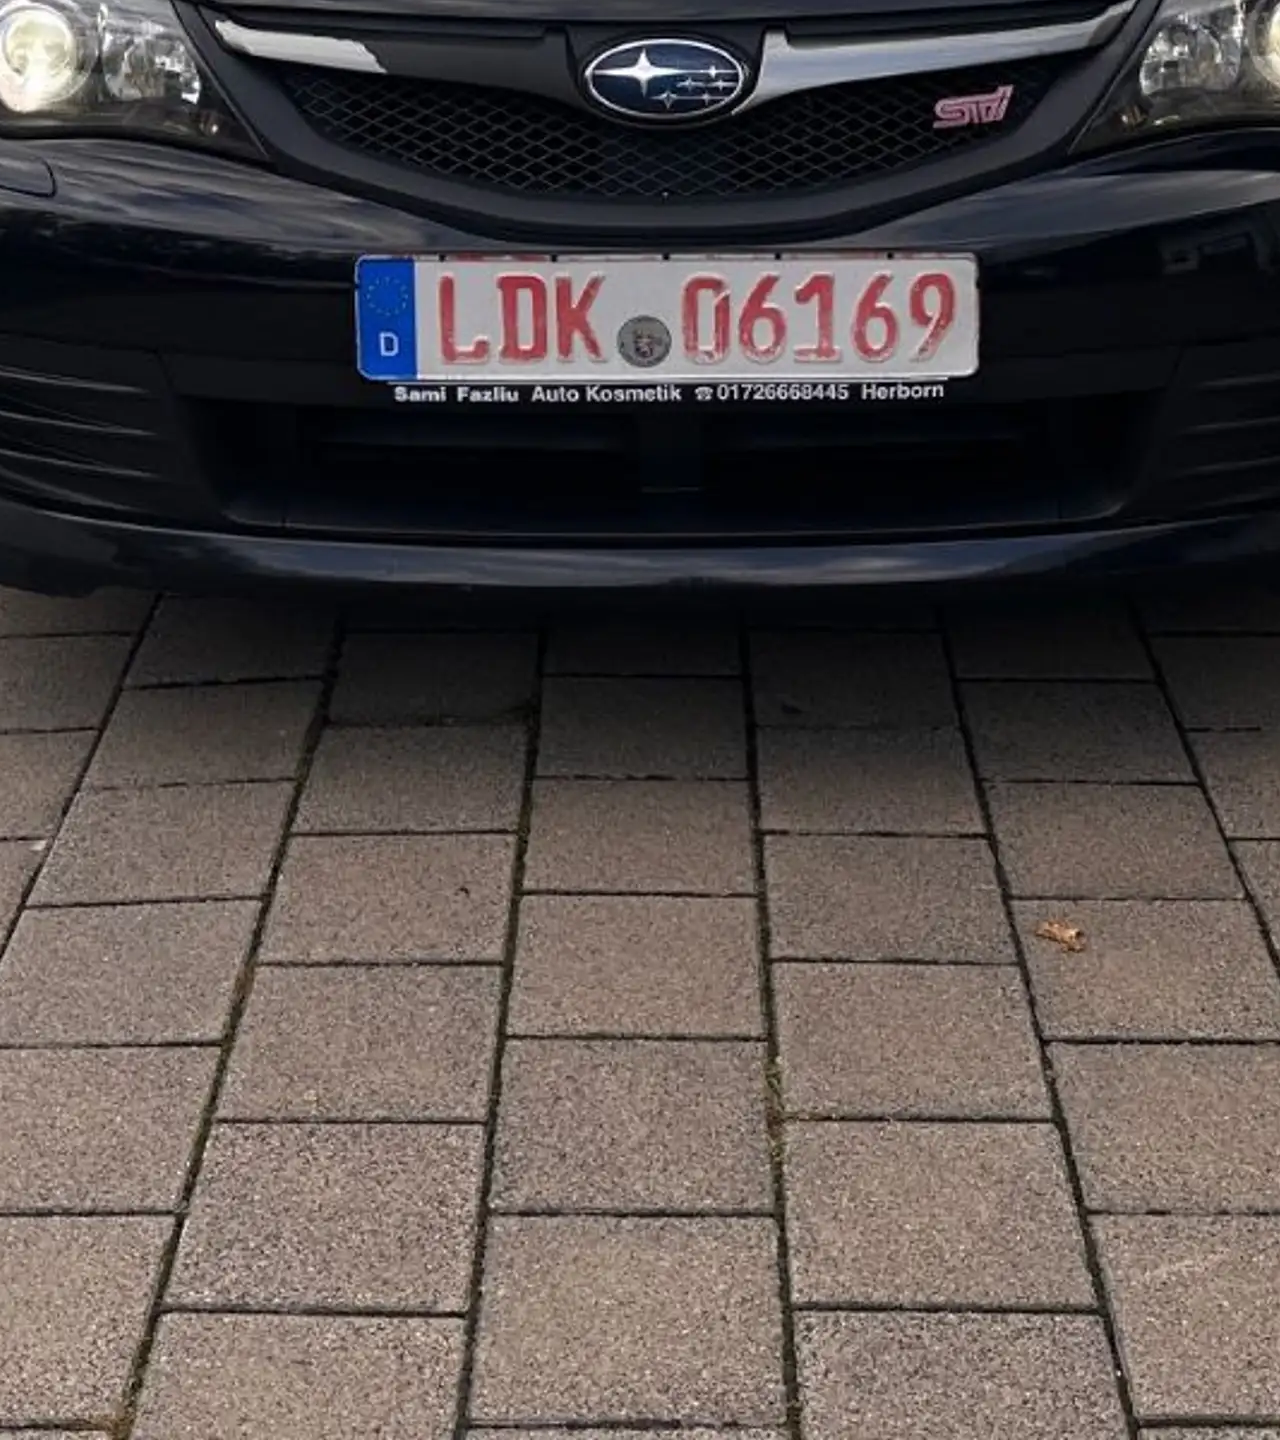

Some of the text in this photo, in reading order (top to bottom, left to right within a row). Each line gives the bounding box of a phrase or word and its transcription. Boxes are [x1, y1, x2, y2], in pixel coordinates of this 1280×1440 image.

[437, 271, 958, 365] LDK 06169
[379, 333, 399, 357] D
[393, 382, 945, 402] Sami Fazliu Auto Kosmetik 01726668445 Herborn
